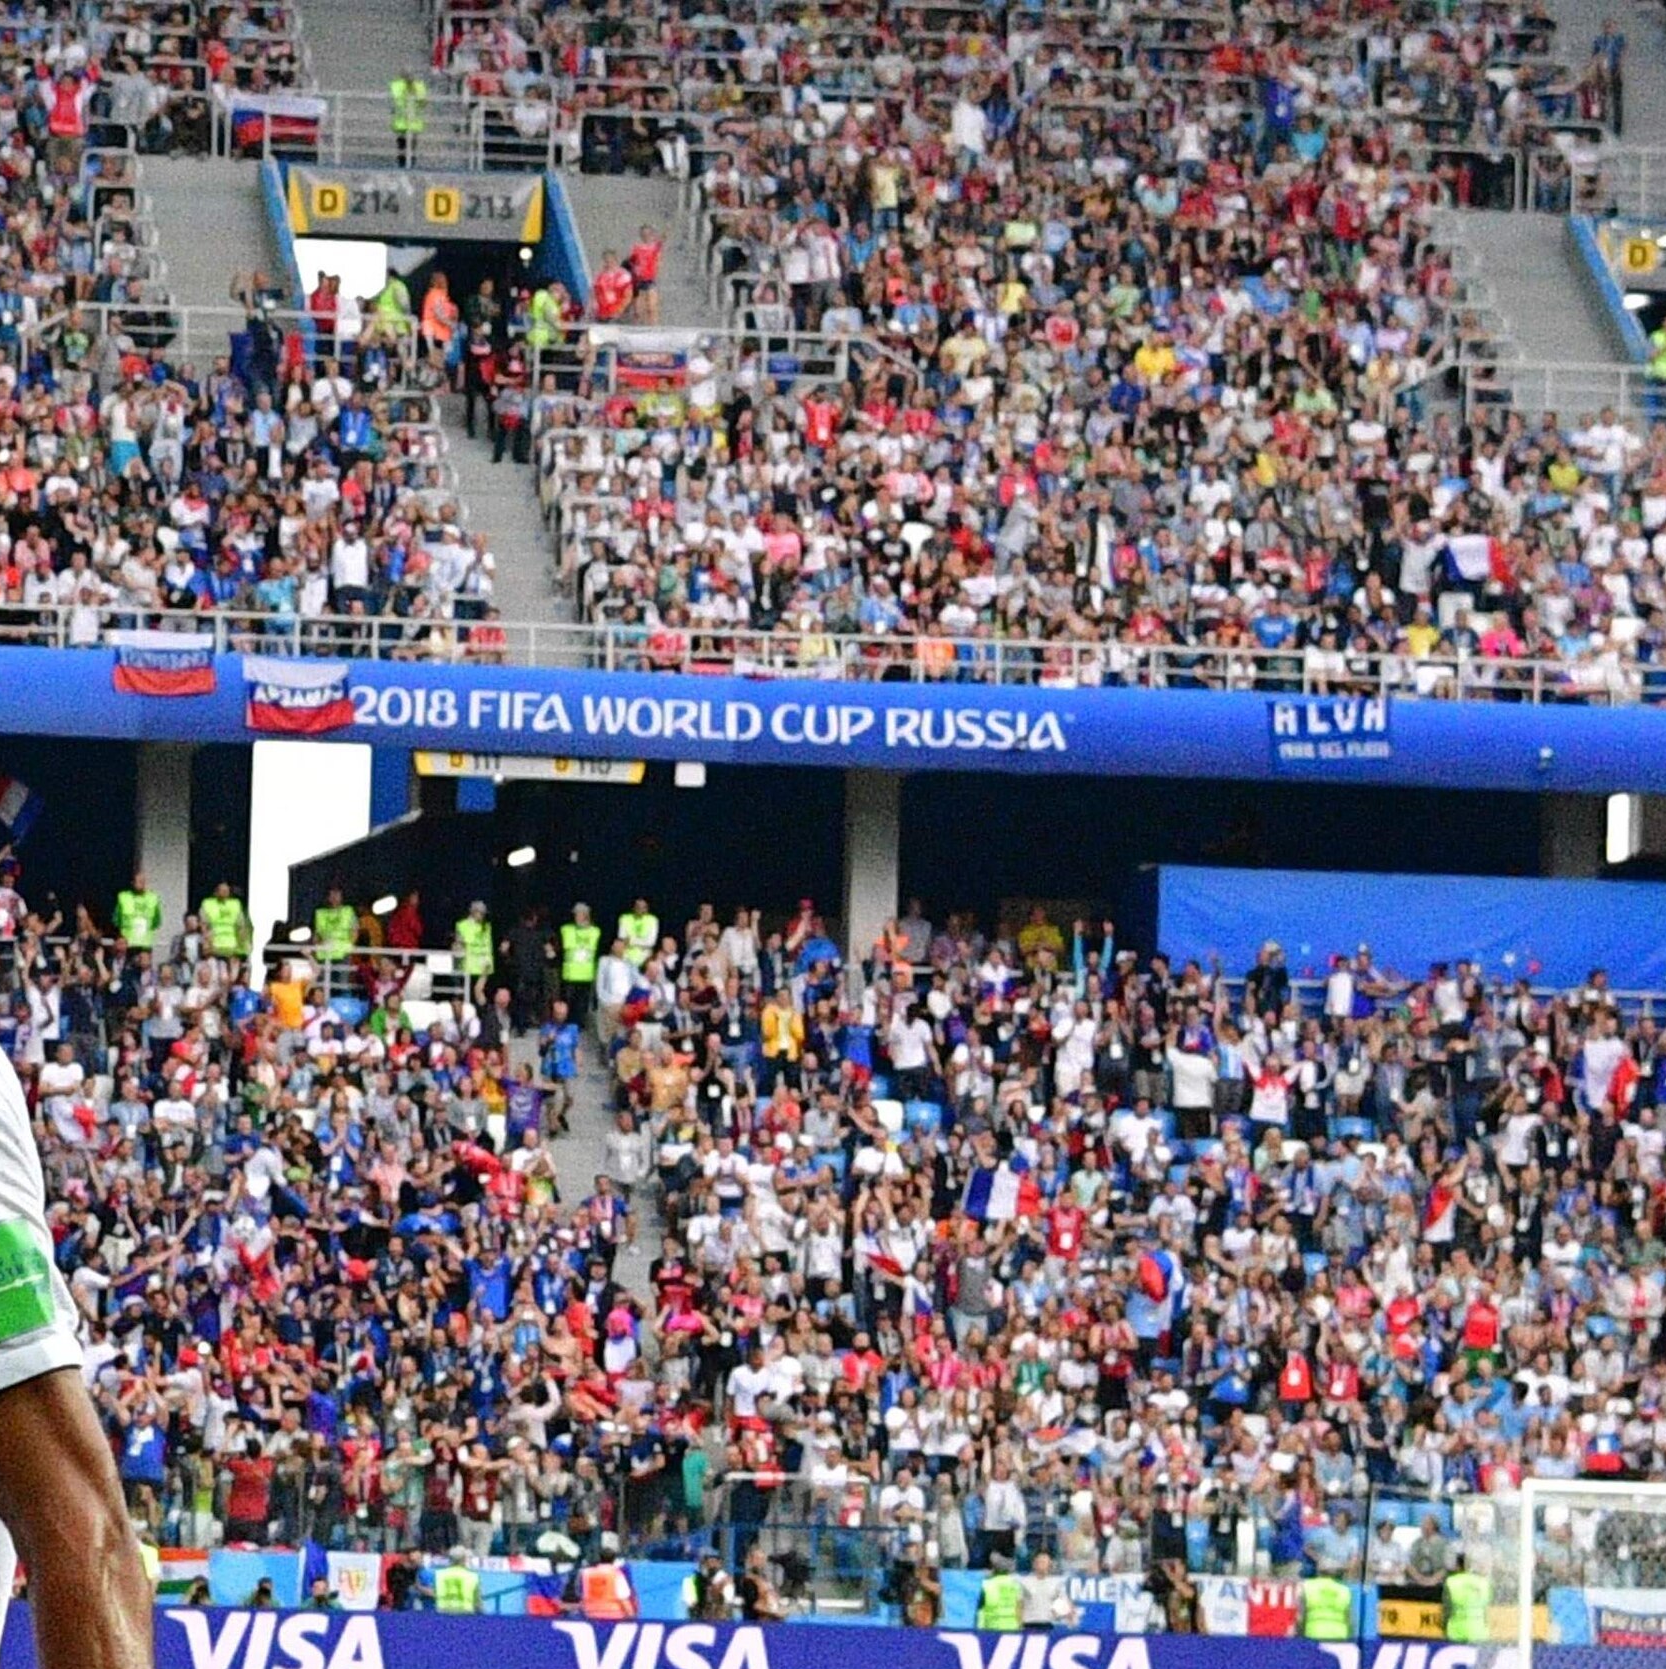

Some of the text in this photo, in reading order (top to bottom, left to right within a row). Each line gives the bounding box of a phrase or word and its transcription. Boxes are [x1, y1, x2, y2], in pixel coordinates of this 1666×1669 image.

[318, 190, 400, 215] D 214
[432, 193, 515, 220] D 213
[351, 685, 1068, 752] 2018 FIFA WORLD CUP RUSSIA
